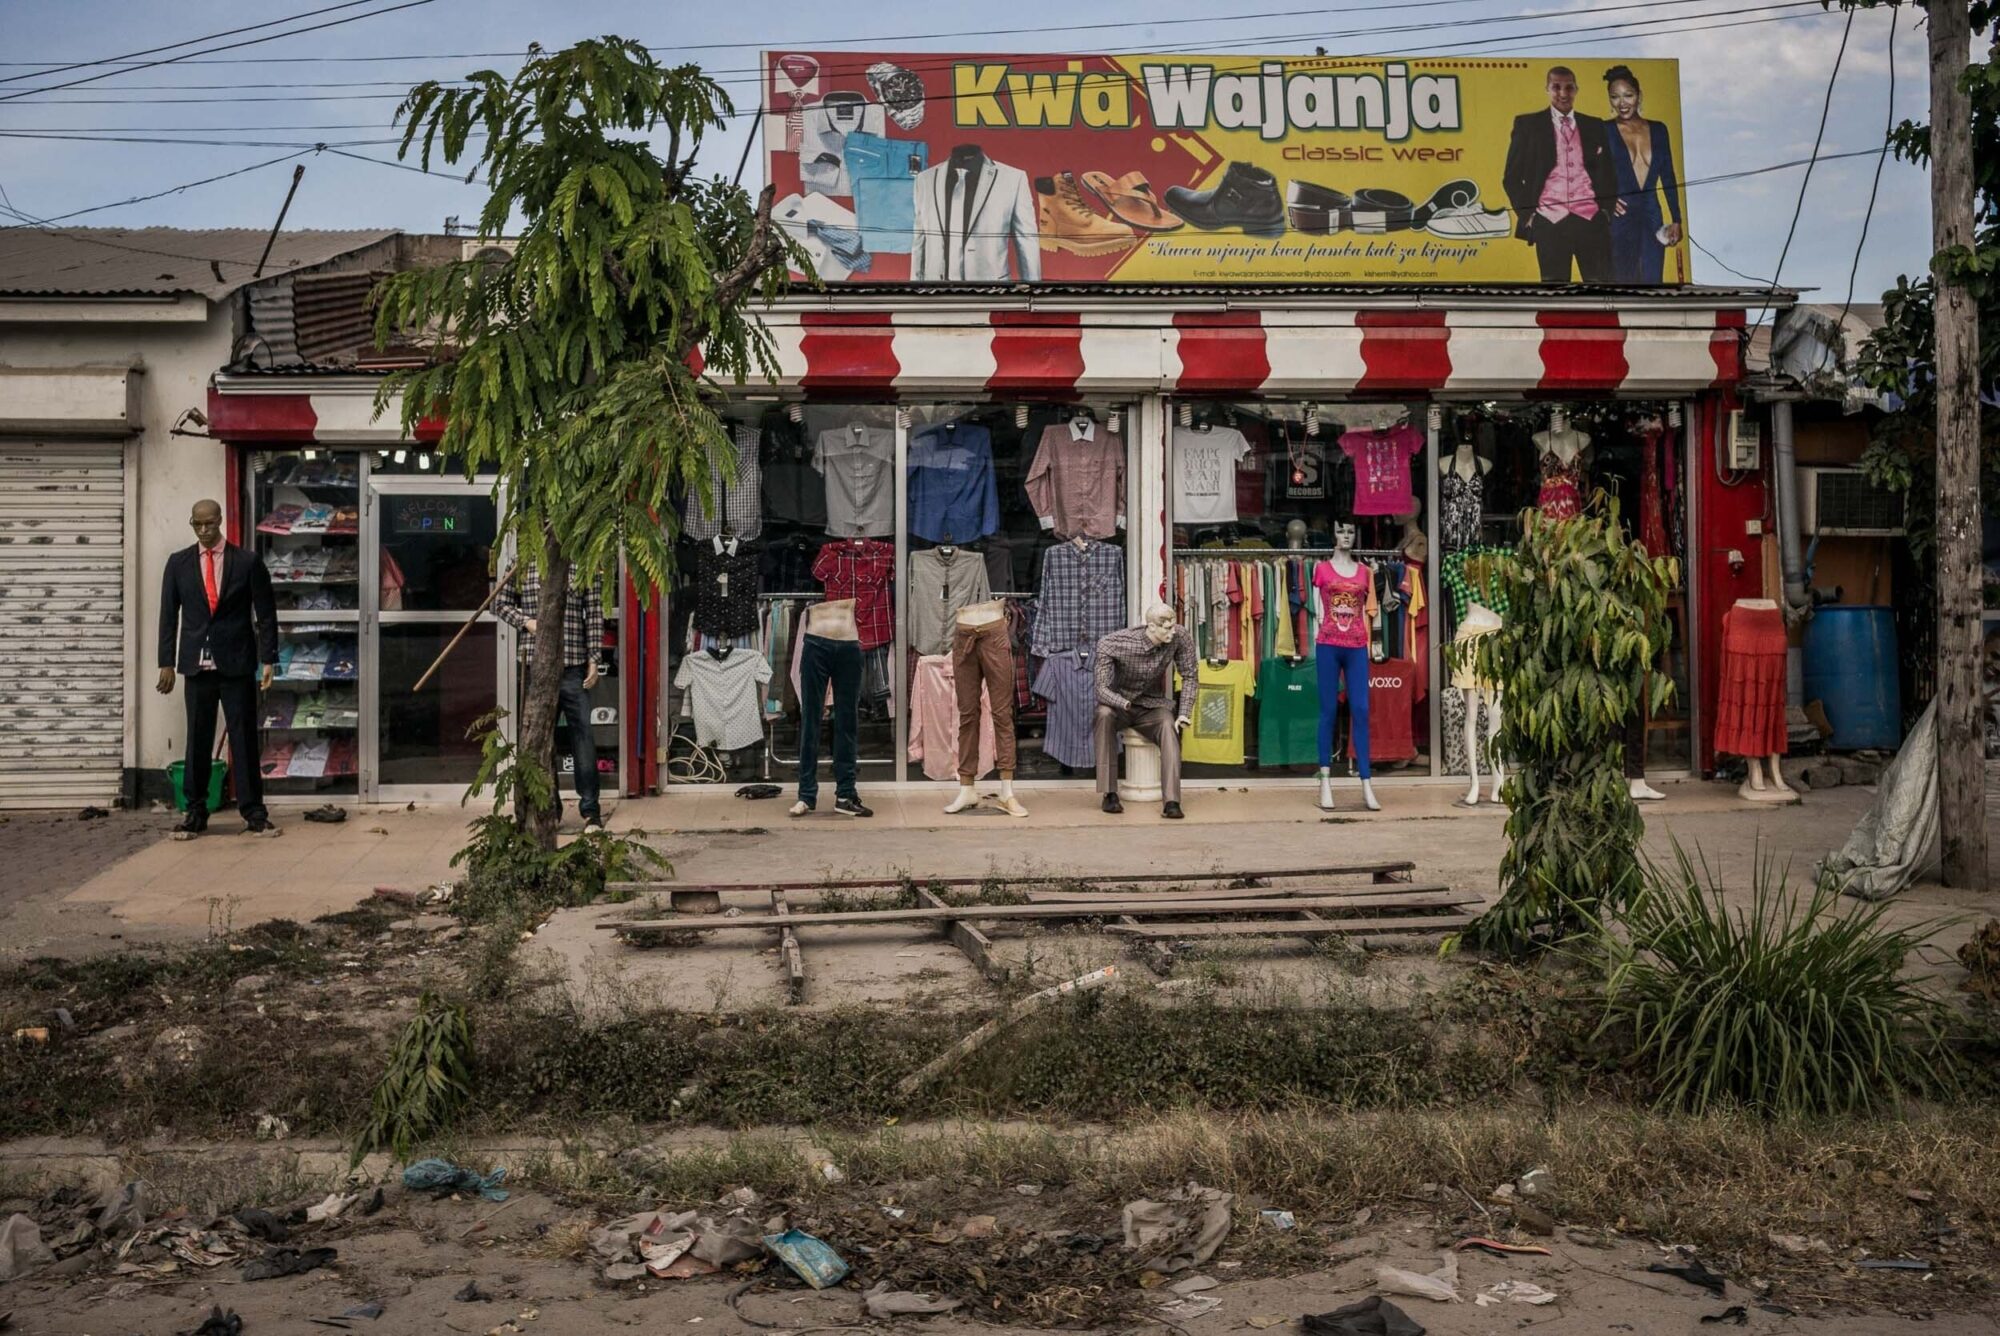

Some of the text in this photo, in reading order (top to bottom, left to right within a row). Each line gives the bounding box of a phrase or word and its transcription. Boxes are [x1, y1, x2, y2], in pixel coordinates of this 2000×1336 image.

[953, 60, 1462, 142] Kwa Wajanja
[1282, 144, 1464, 161] classic wear
[1207, 243, 1266, 264] mjanja
[1271, 240, 1302, 257] kwa
[1289, 487, 1322, 496] RECORDS
